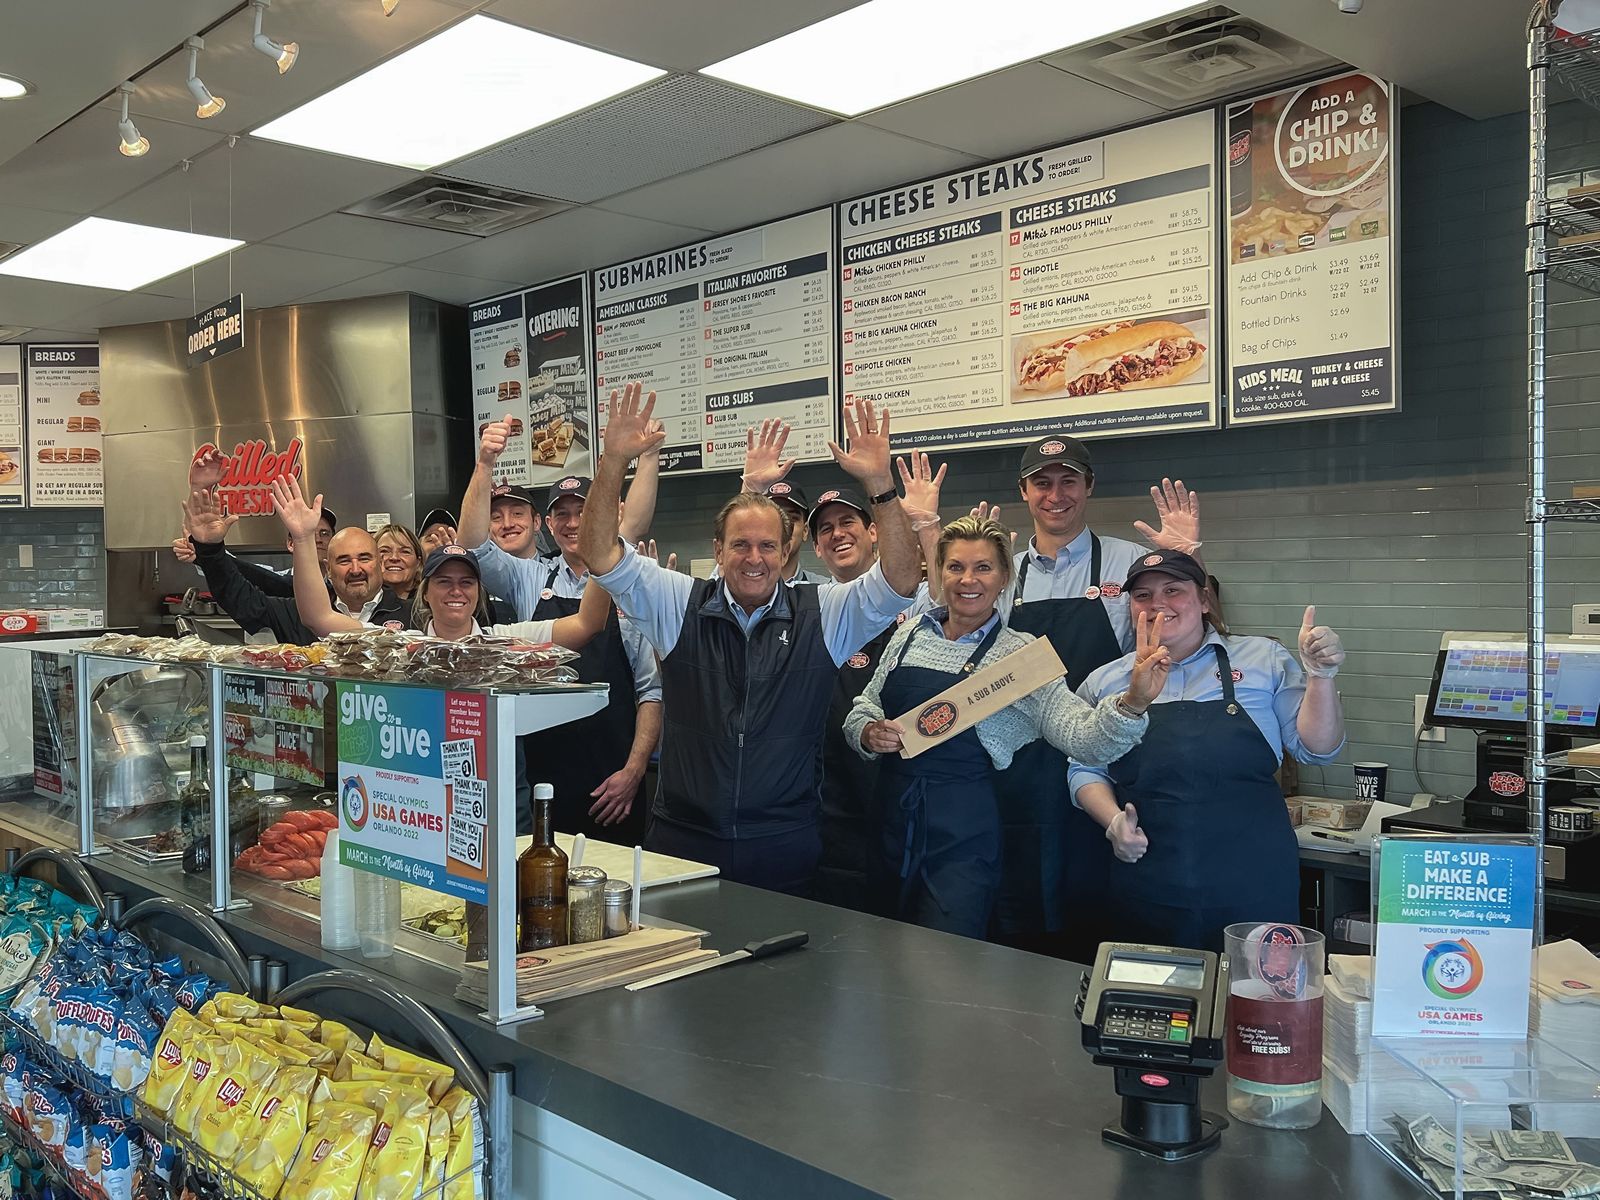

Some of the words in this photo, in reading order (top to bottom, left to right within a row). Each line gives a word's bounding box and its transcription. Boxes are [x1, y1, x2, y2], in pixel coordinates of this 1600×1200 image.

[1311, 94, 1340, 112] ADD
[1345, 91, 1354, 102] A
[1290, 109, 1348, 142] CHIP
[1359, 103, 1376, 125] &
[1289, 127, 1378, 168] DRINK!
[1049, 162, 1066, 171] FRESH
[1068, 155, 1092, 167] GRILLED
[1058, 167, 1080, 178] ORDER!
[848, 184, 935, 226] CHEESE
[948, 156, 1044, 204] STEAKS
[1016, 201, 1062, 224] CHEESE
[1068, 189, 1116, 213] STEAKS
[1050, 221, 1082, 236] FAMOUS
[1085, 215, 1112, 228] PHILLY
[848, 240, 891, 260] CHICKEN
[895, 230, 935, 250] CHEESE
[939, 220, 981, 240] STEAKS
[876, 260, 901, 272] CHICKEN
[904, 255, 926, 266] PHILLY
[1330, 259, 1348, 268] $3.49
[1359, 253, 1379, 263] $3.69
[600, 245, 707, 292] SUBMARINES
[1023, 263, 1059, 276] CHIPOTLE
[1240, 275, 1256, 284] Add
[1261, 270, 1281, 280] Chip
[1285, 268, 1291, 276] &
[1295, 263, 1317, 274] Drink
[707, 277, 738, 294] ITALIAN
[741, 265, 787, 285] FAVORITES
[1330, 282, 1349, 292] $2.29
[1360, 278, 1378, 287] $2.49
[712, 299, 729, 309] JERSEY
[752, 288, 776, 301] FAVORITE
[854, 296, 879, 308] CHICKEN
[881, 292, 902, 304] BACON
[905, 289, 926, 300] RANCH
[1023, 302, 1038, 311] THE
[1040, 299, 1053, 309] BIG
[1056, 293, 1089, 306] KAHUNA
[1240, 293, 1276, 306] Fountain
[1281, 288, 1306, 300] Drinks
[473, 305, 501, 321] BREADS
[600, 300, 634, 319] AMERICAN
[637, 294, 667, 309] CLASSICS
[1330, 308, 1349, 316] $2.69
[199, 312, 212, 326] PLACE
[214, 307, 227, 319] YOUR
[529, 307, 579, 337] CATERING!
[1241, 318, 1270, 330] Bottled
[1274, 314, 1300, 325] Drinks
[189, 329, 215, 354] ORDER
[217, 314, 240, 338] HERE
[1330, 332, 1348, 341] $1.49
[1241, 343, 1257, 354] Bag
[1260, 341, 1269, 350] of
[1272, 338, 1296, 348] Chips
[35, 352, 75, 361] BREADS
[855, 360, 883, 371] CHIPOTLE
[886, 357, 911, 367] CHICKEN
[1311, 364, 1342, 374] TURKEY
[1345, 362, 1351, 370] &
[1354, 359, 1383, 369] CHEESE
[1238, 370, 1267, 390] KIDS
[1271, 368, 1302, 384] MEAL
[1311, 378, 1329, 388] HAM
[1332, 377, 1338, 385] &
[1341, 373, 1370, 384] CHEESE
[710, 395, 730, 408] CLUB
[733, 392, 754, 404] SUBS
[1268, 392, 1279, 401] sub,
[1362, 389, 1379, 397] $5.45
[1183, 410, 1203, 418] request.
[1241, 404, 1262, 412] cookie.
[1264, 401, 1292, 409] 400-630
[217, 489, 274, 515] FRESH
[967, 696, 974, 705] A
[973, 687, 989, 702] SUB
[991, 672, 1015, 693] ABOVE
[341, 685, 387, 725] give
[450, 708, 466, 716] member
[387, 713, 395, 723] to
[380, 717, 430, 759] give
[466, 728, 481, 736] donate
[443, 743, 457, 753] THANK
[459, 741, 469, 750] YOU
[1489, 772, 1526, 785] Jersey
[373, 790, 396, 801] SPECIAL
[398, 795, 428, 809] OLYMPICS
[373, 803, 396, 822] USA
[400, 810, 443, 832] GAMES
[373, 822, 402, 835] ORLANDO
[404, 829, 418, 840] 2022
[1425, 850, 1450, 864] EAT
[1460, 852, 1489, 866] SUB
[347, 848, 368, 864] MARCH
[382, 853, 403, 871] Month
[405, 863, 411, 873] of
[413, 863, 434, 885] Giving
[1425, 869, 1471, 884] MAKE
[1477, 871, 1488, 884] A
[1407, 884, 1507, 903] DIFFERENCE
[1486, 913, 1511, 923] Giving
[1444, 1013, 1483, 1021] GAMES
[1269, 1046, 1290, 1054] SUBS!
